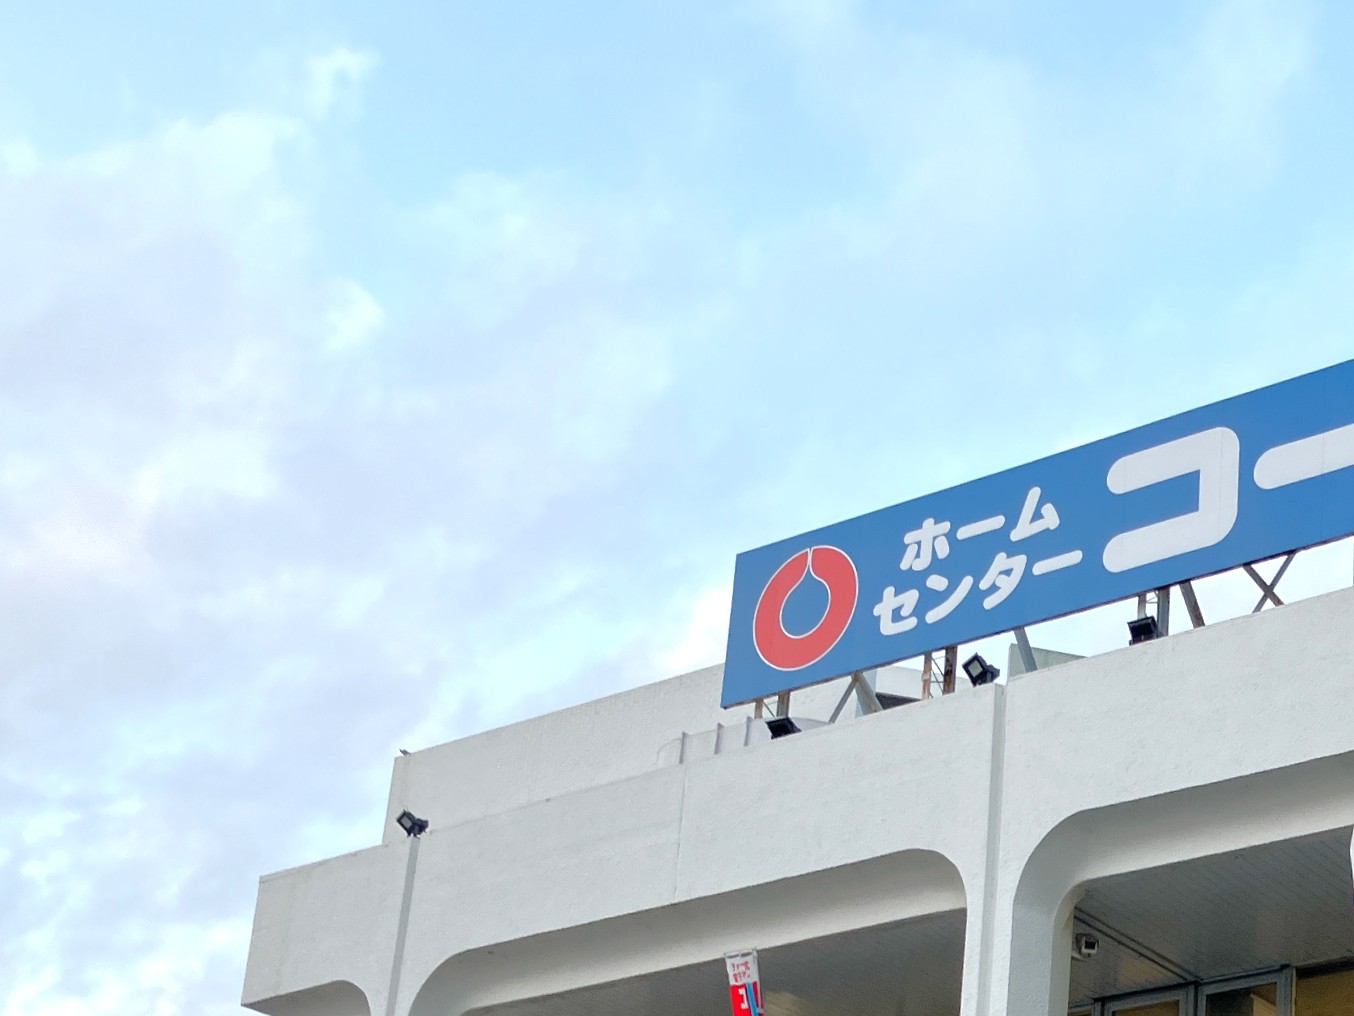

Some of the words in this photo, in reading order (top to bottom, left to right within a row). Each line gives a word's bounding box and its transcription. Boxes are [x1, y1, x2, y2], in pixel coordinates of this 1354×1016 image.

[899, 486, 1060, 571] ホーム
[874, 548, 1083, 638] センター
